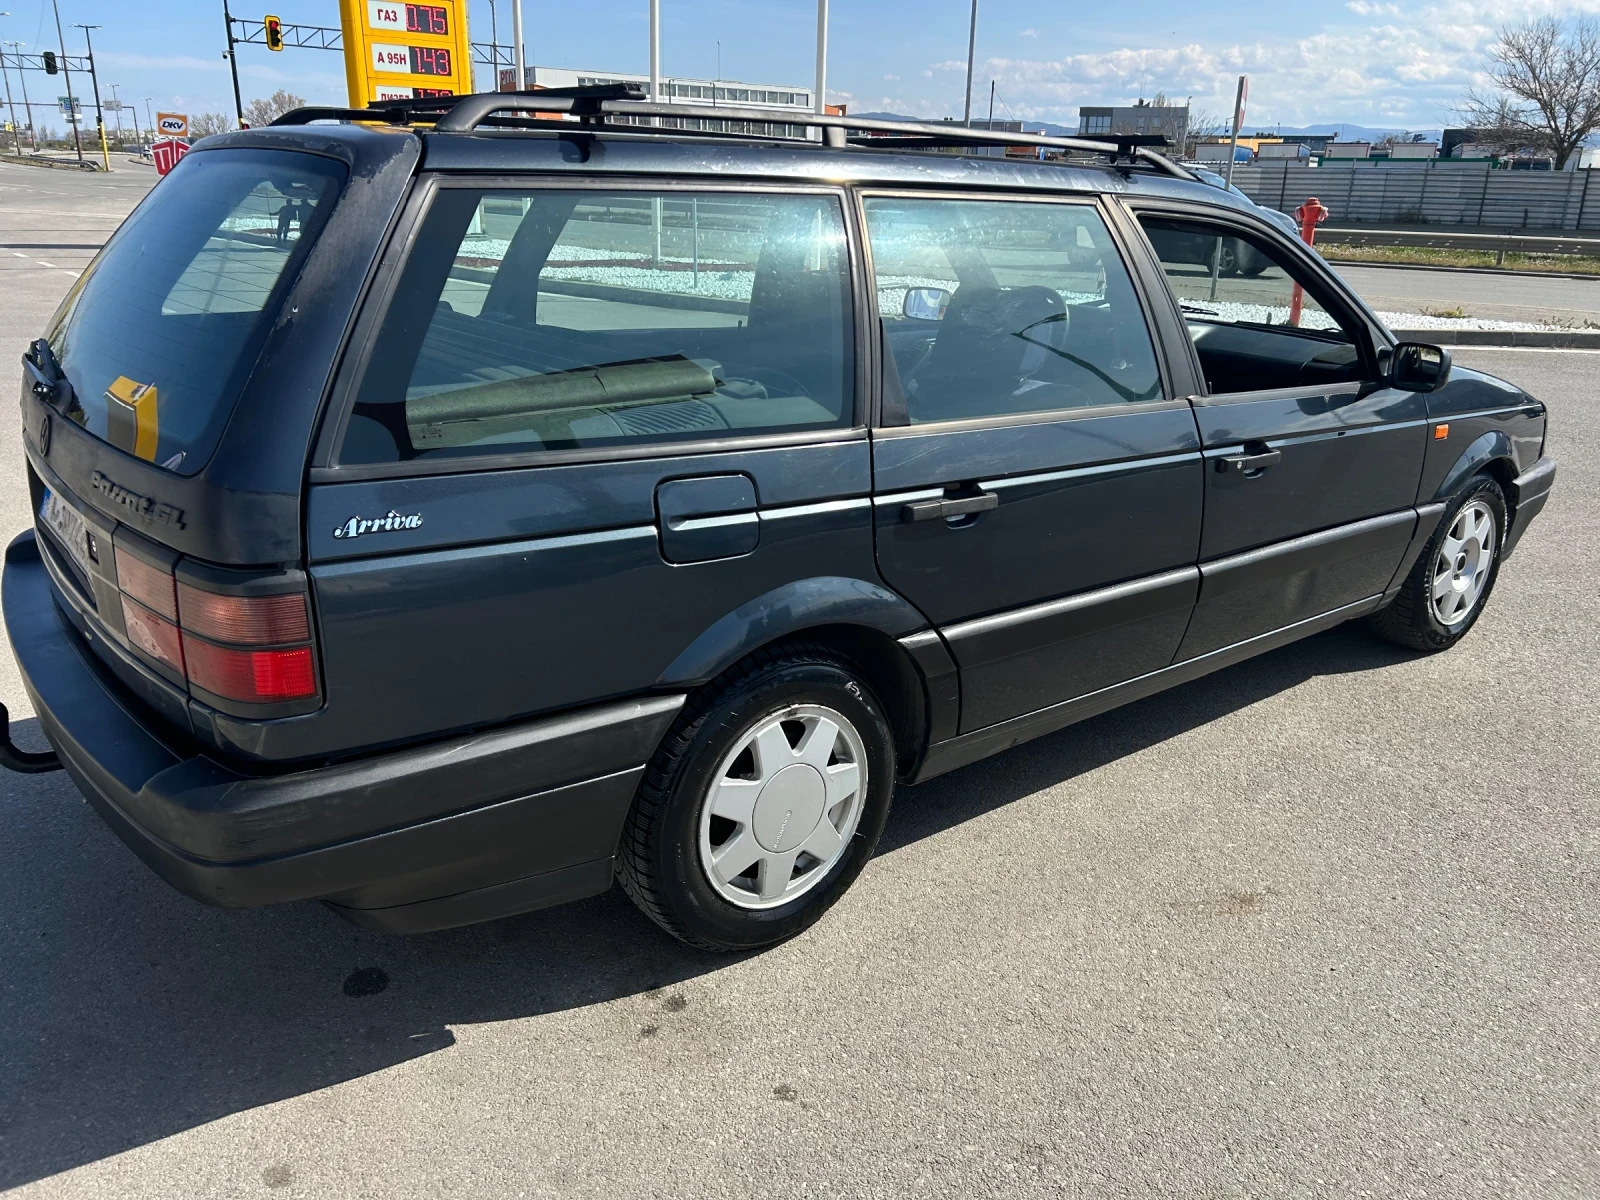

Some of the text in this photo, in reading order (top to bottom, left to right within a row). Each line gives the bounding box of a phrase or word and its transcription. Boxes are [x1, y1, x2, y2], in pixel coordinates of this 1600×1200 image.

[377, 8, 398, 22] ГАЗ
[405, 5, 446, 34] 0.75
[415, 47, 449, 75] 1.43
[161, 120, 184, 130] DKV
[333, 509, 423, 538] Arriva
